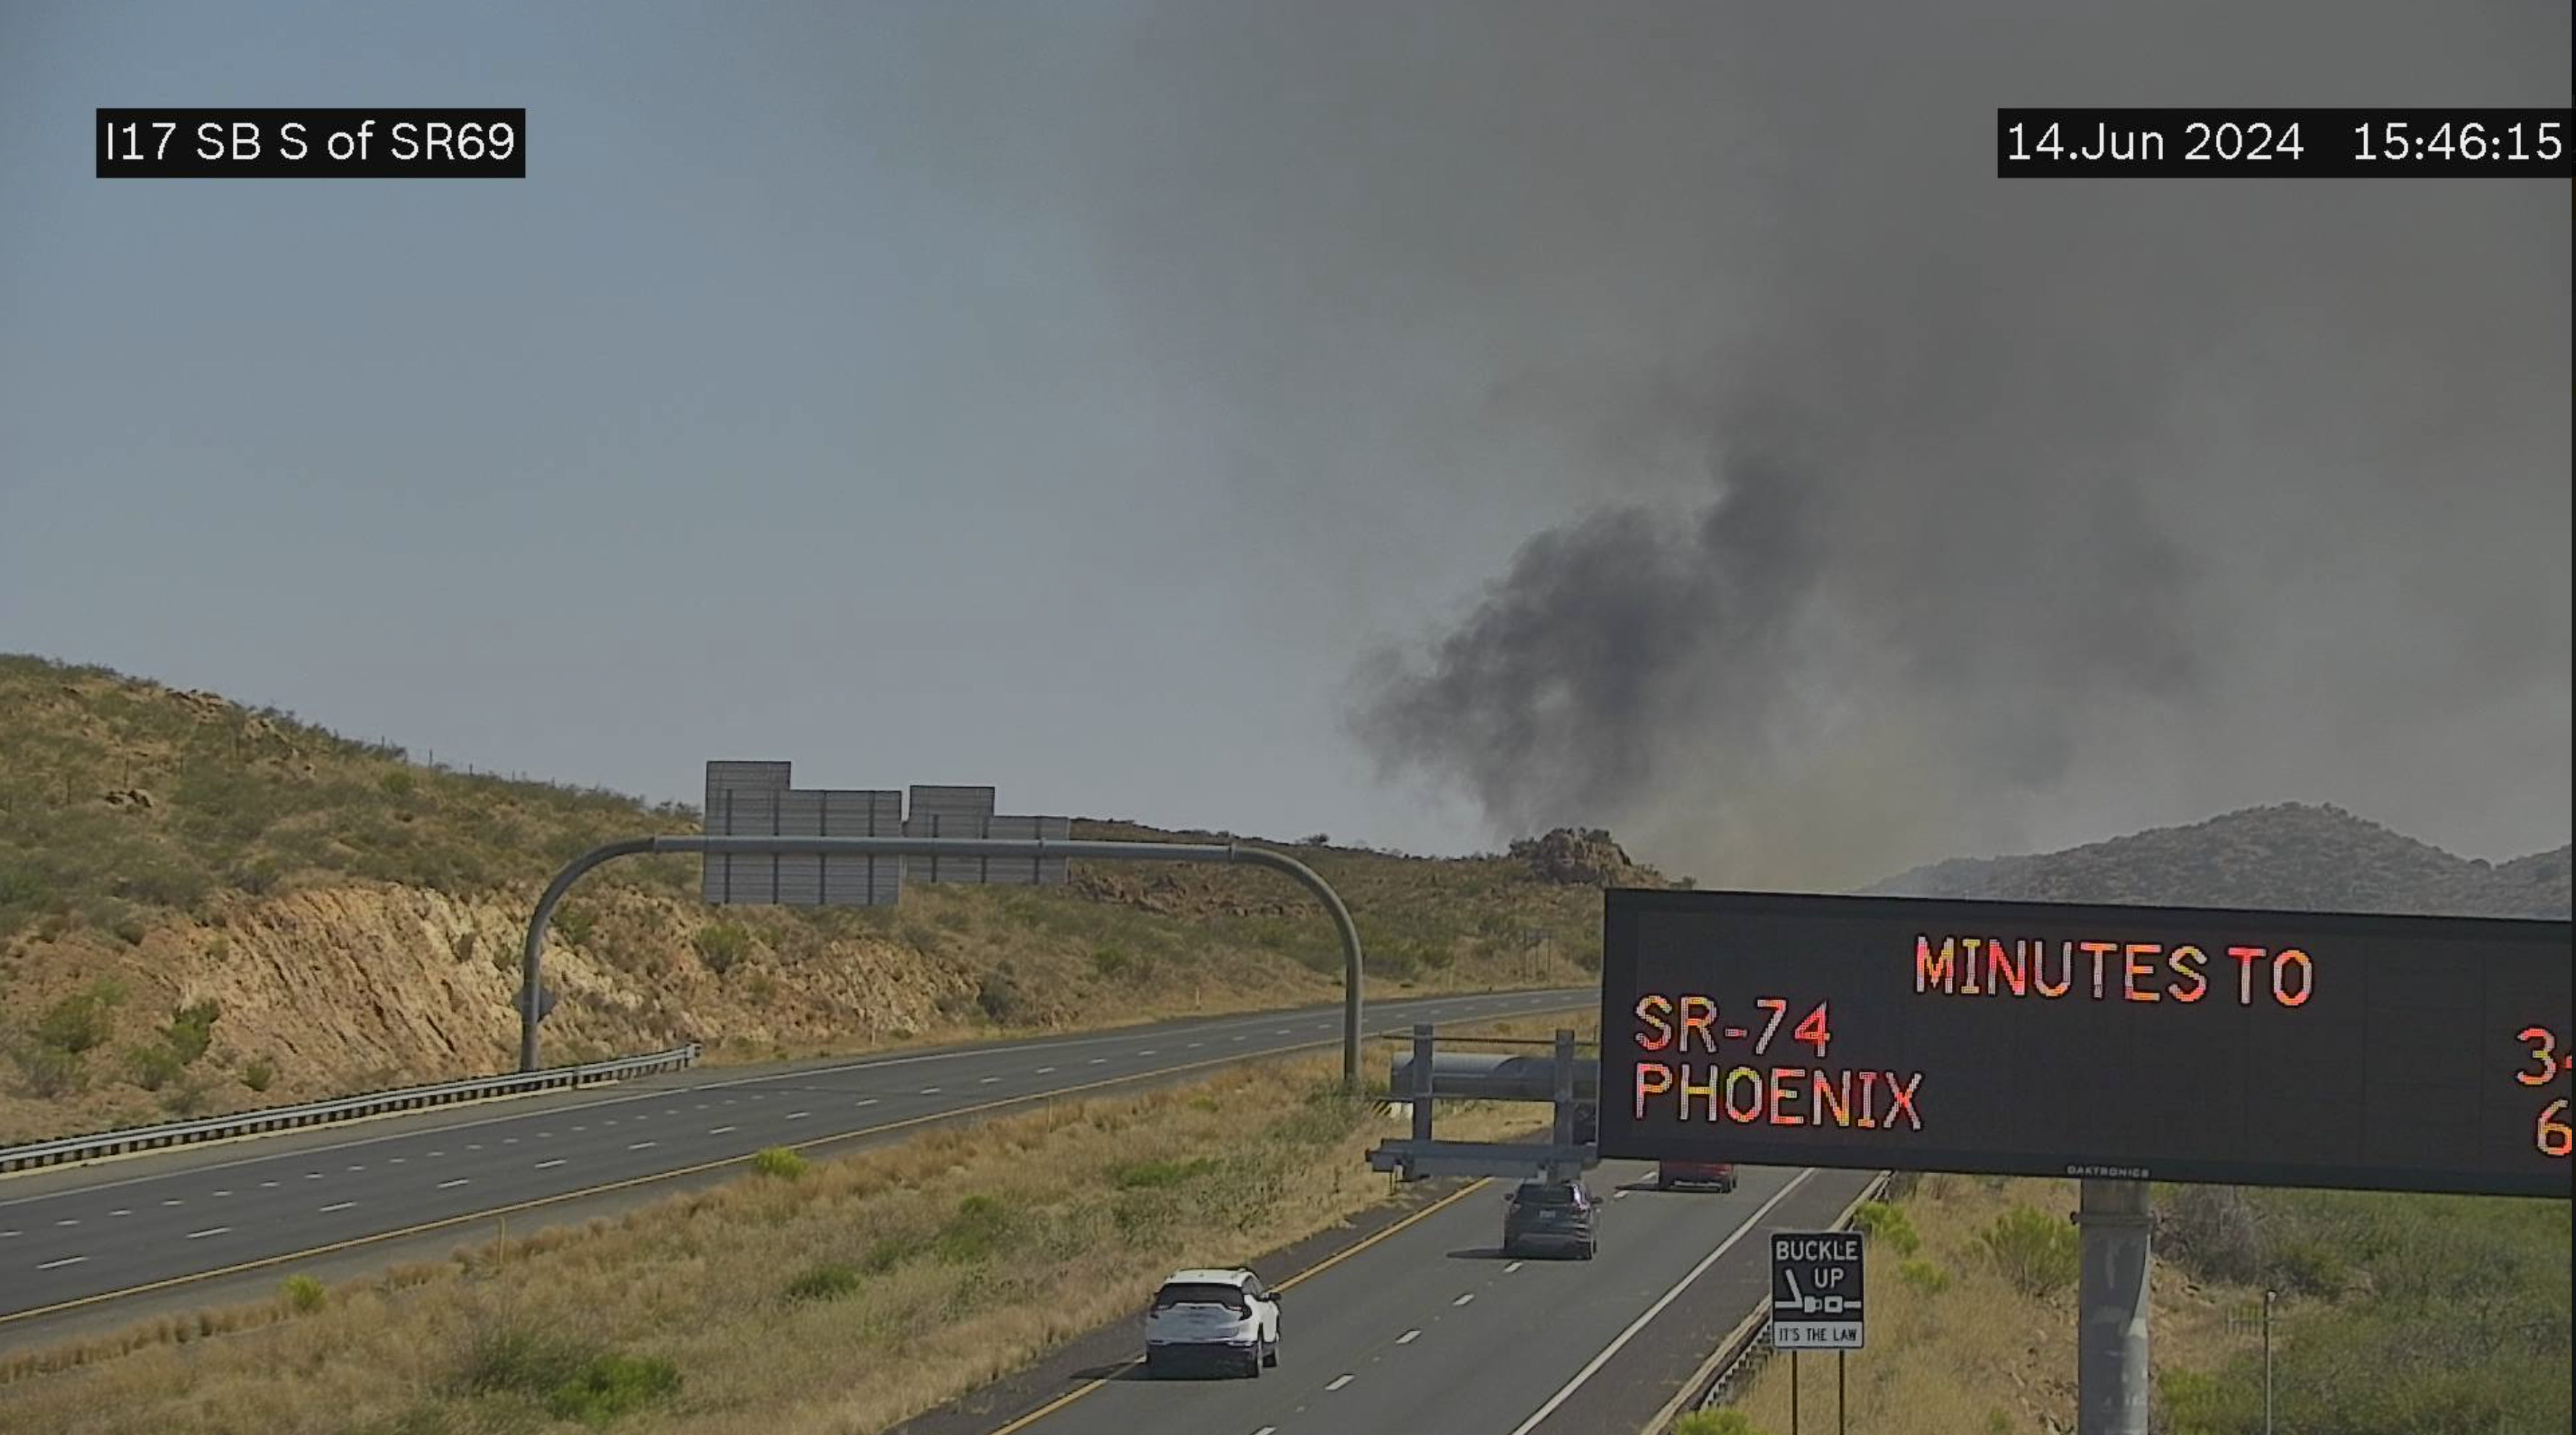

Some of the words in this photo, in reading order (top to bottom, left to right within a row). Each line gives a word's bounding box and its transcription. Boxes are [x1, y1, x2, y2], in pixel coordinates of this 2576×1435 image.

[1915, 935, 2209, 1003] MINUTES
[2227, 946, 2314, 1008] TO
[1634, 994, 1831, 1057] SR-74
[2517, 1027, 2572, 1085] 3
[1634, 1063, 1924, 1131] PHOENIX
[2066, 1164, 2150, 1178] DAKTRONICS
[1775, 1240, 1859, 1261] BUCKLE
[1814, 1267, 1845, 1289] UP
[1779, 1327, 1801, 1342] IT'S
[1807, 1327, 1827, 1342] THE
[1833, 1327, 1857, 1342] LAW
